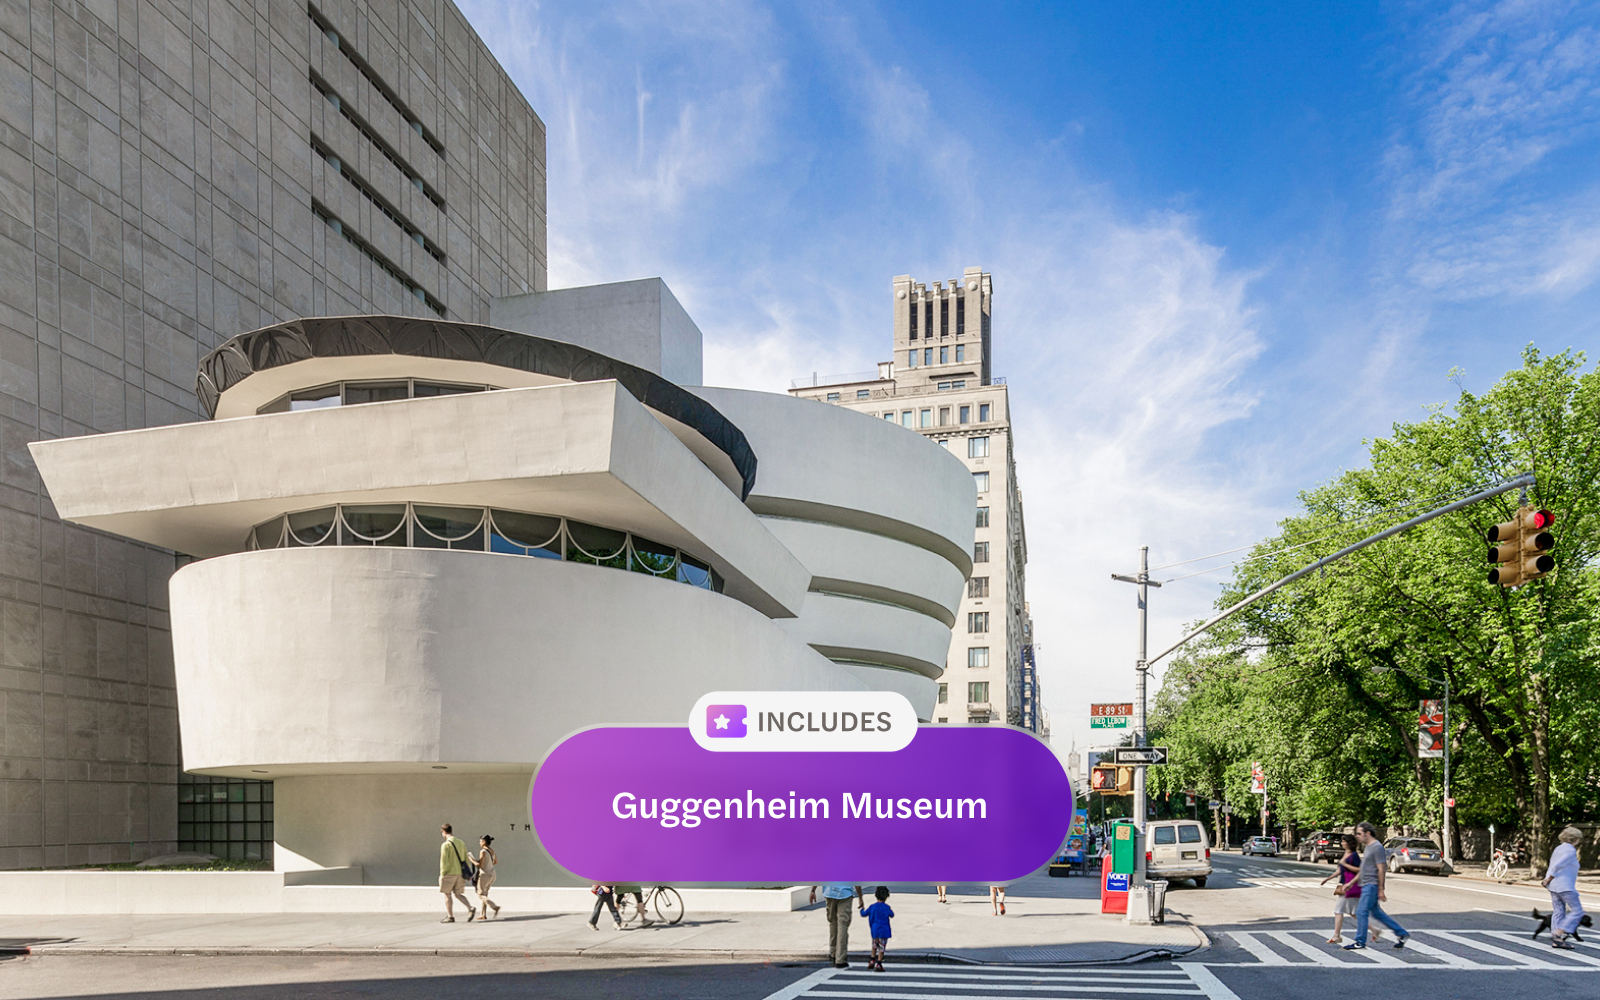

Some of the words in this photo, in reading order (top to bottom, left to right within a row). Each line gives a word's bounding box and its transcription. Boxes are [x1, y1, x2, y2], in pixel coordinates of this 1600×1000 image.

[1099, 706, 1103, 715] E
[1106, 706, 1115, 715] 89
[1118, 706, 1126, 715] St
[1091, 717, 1106, 725] FRED
[1122, 752, 1138, 760] ONE
[1144, 752, 1160, 760] WAY
